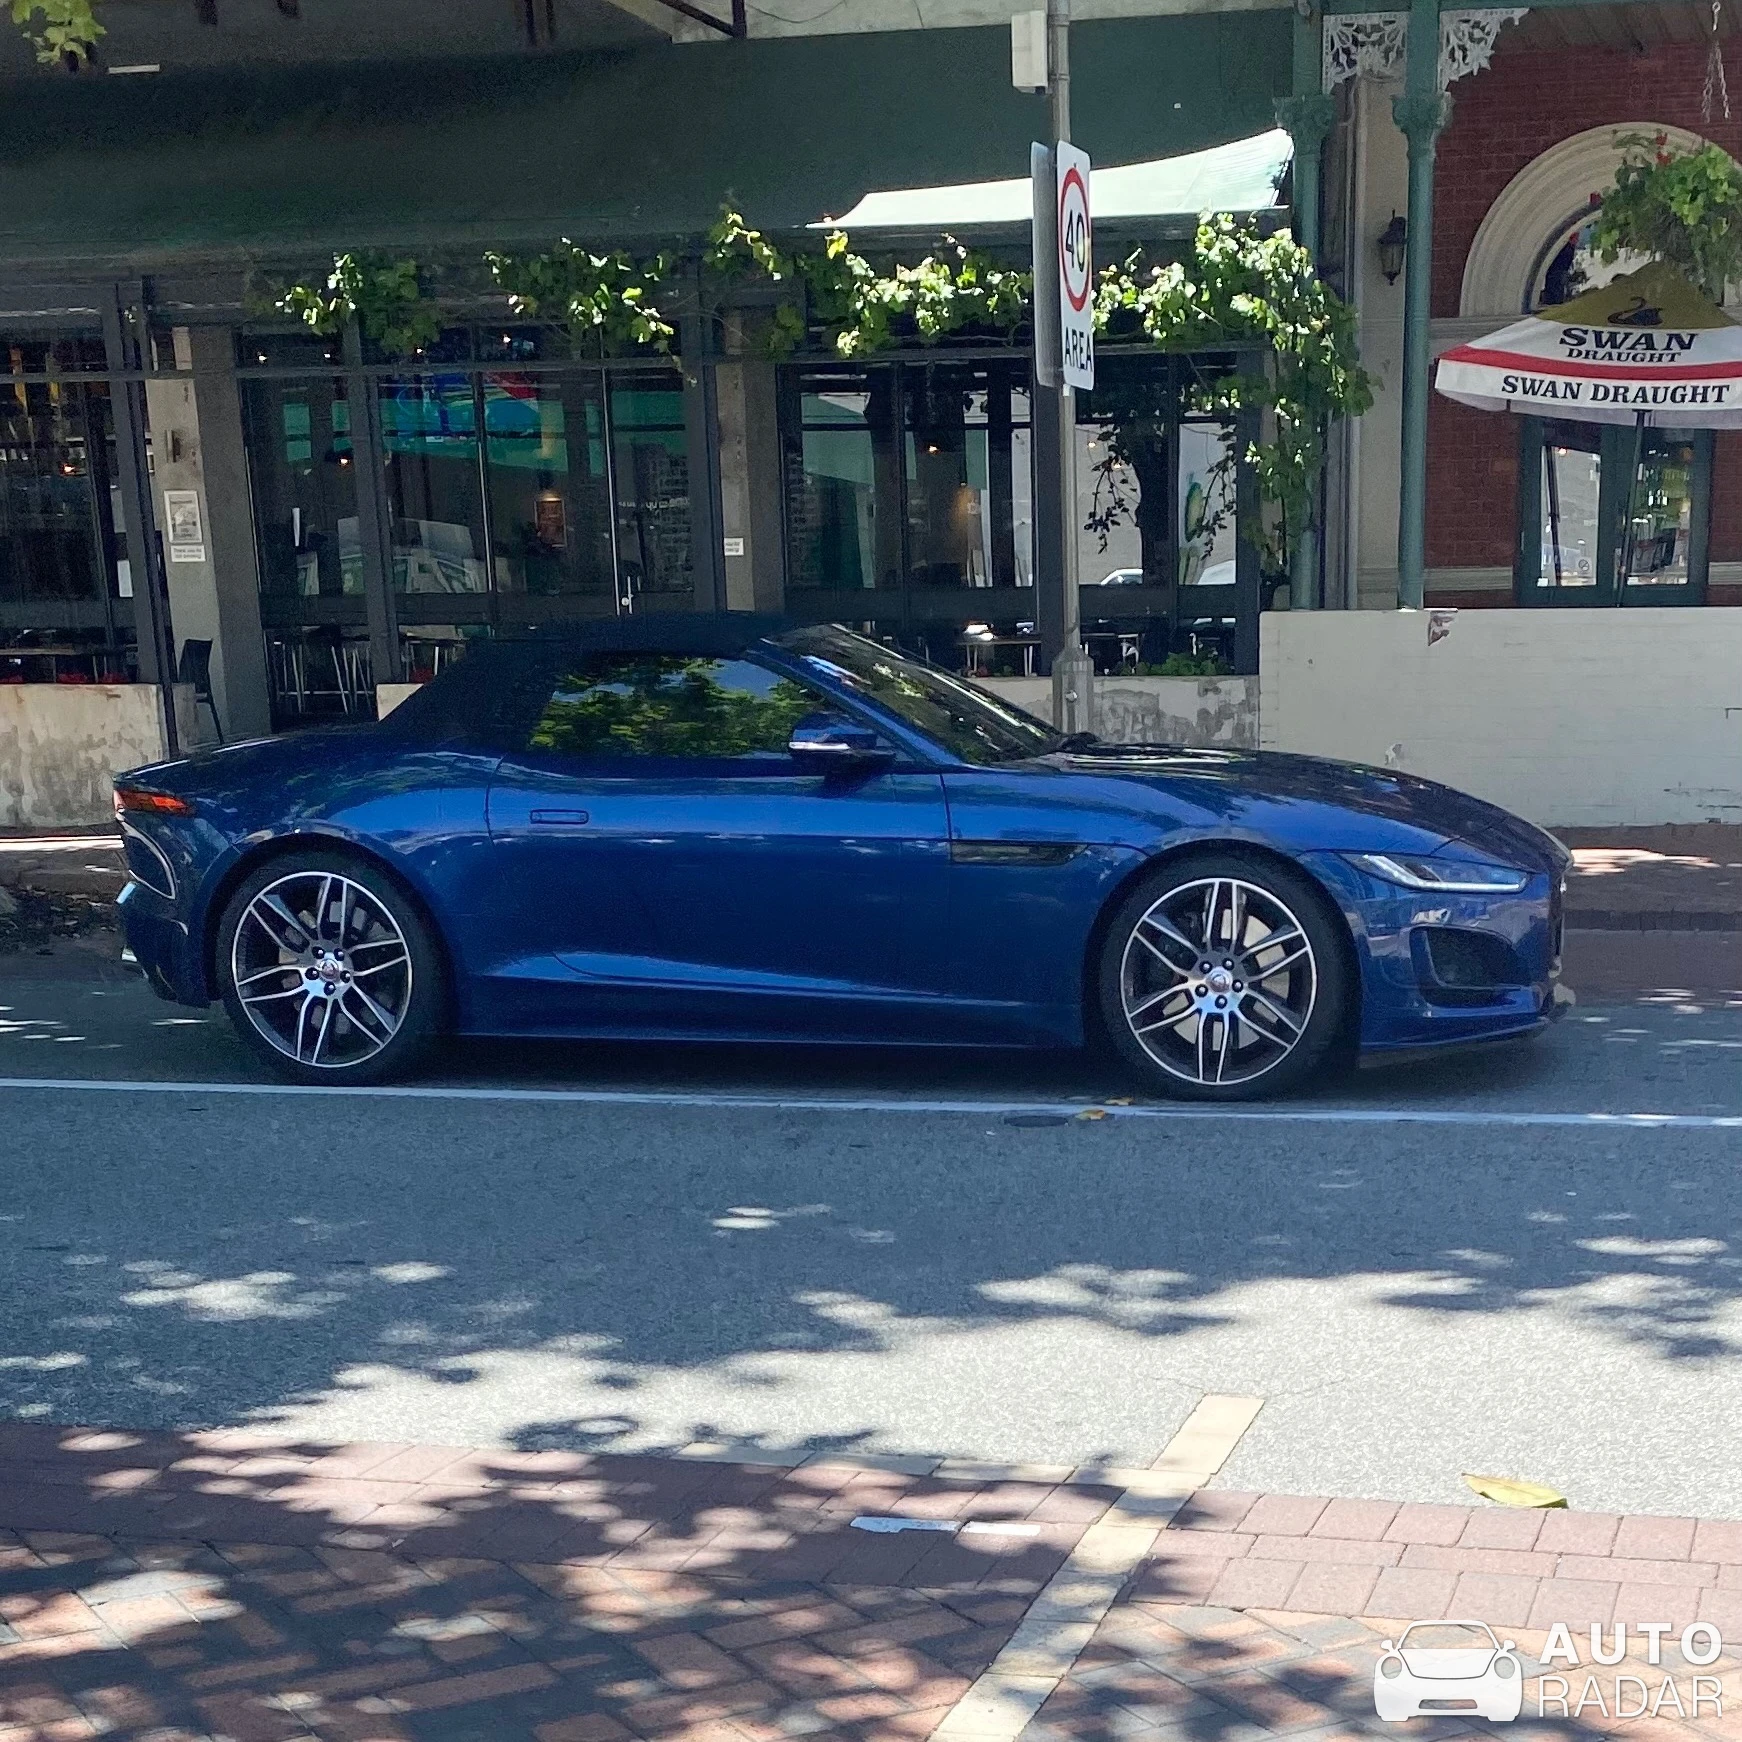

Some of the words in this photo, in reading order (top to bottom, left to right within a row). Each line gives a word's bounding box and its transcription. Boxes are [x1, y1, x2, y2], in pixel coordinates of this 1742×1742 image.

[1065, 209, 1086, 273] 40
[1065, 326, 1093, 372] AREA
[1559, 327, 1698, 351] SWAN
[1567, 347, 1682, 363] DRAUGHT
[1501, 375, 1583, 400] SWAN
[1590, 383, 1730, 404] DRAUGHT
